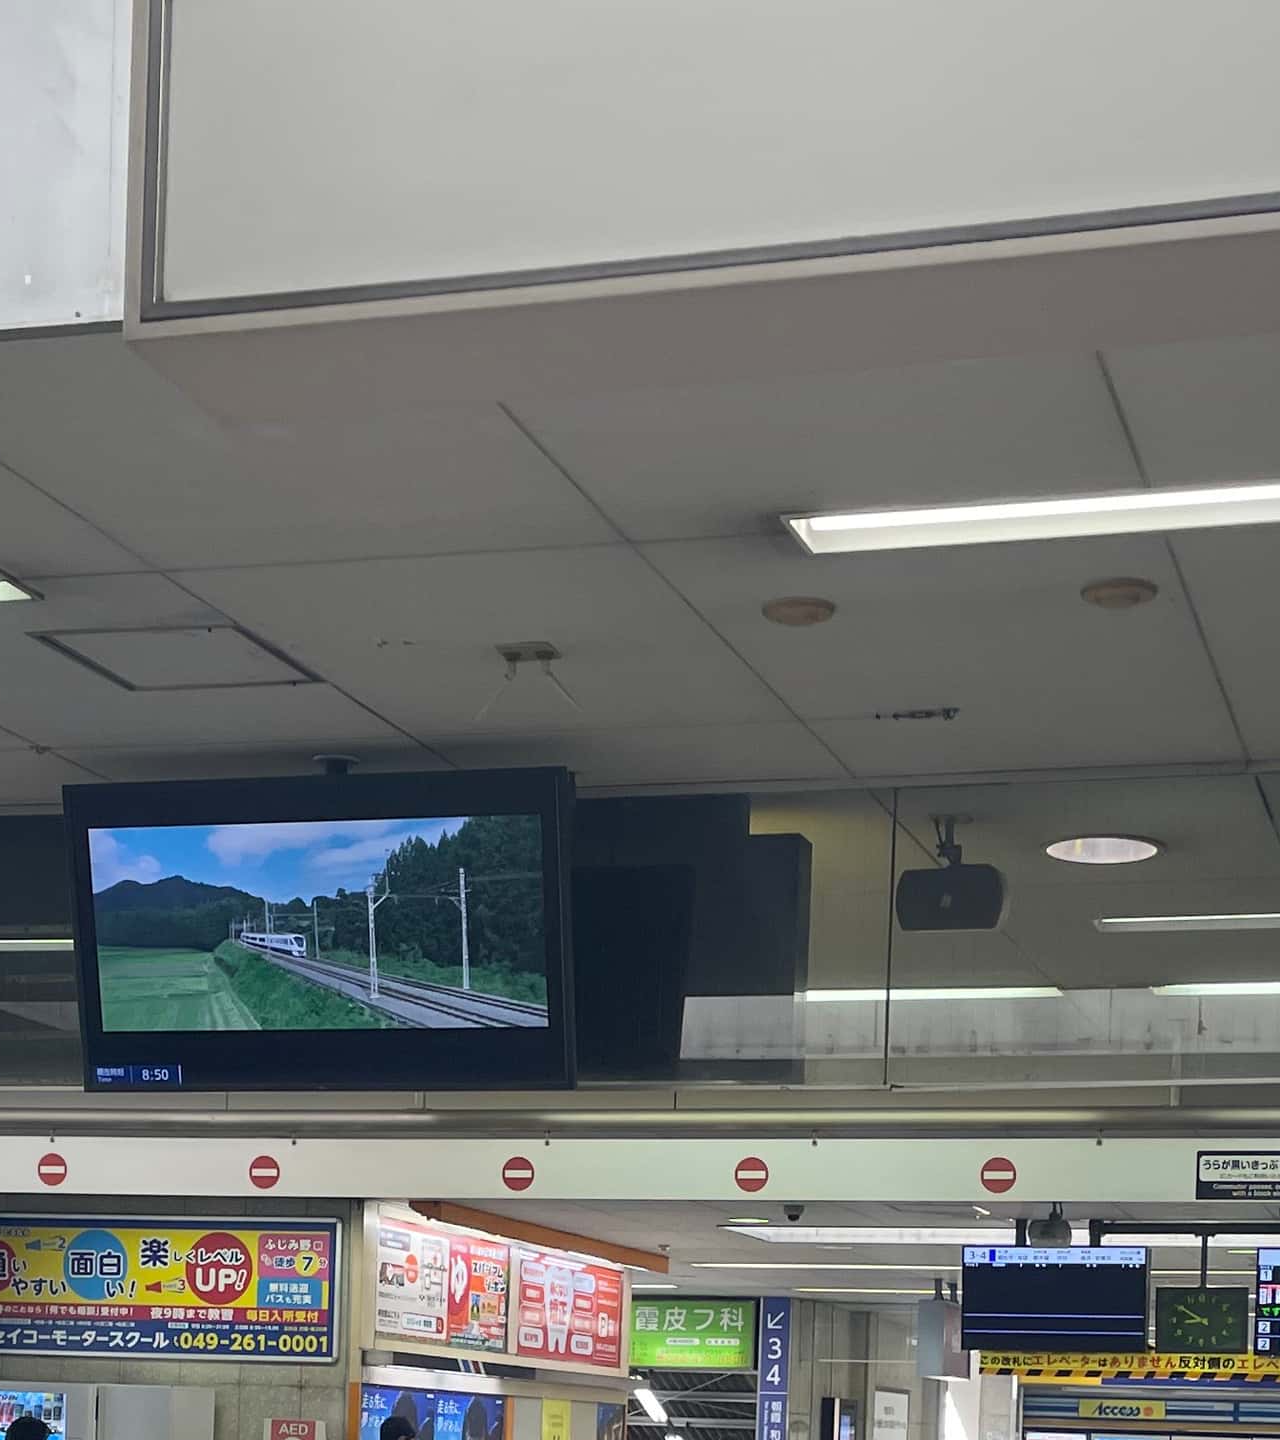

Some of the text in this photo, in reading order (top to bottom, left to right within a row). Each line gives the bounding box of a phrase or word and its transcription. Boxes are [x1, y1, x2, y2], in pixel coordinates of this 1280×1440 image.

[142, 1069, 169, 1080] 8:50
[11, 1278, 67, 1297] やすい
[635, 1306, 745, 1332] 霞皮フ科
[179, 1332, 329, 1353] 049-261-0001
[768, 1338, 782, 1360] 3
[766, 1363, 782, 1386] 4
[278, 1424, 308, 1436] AED
